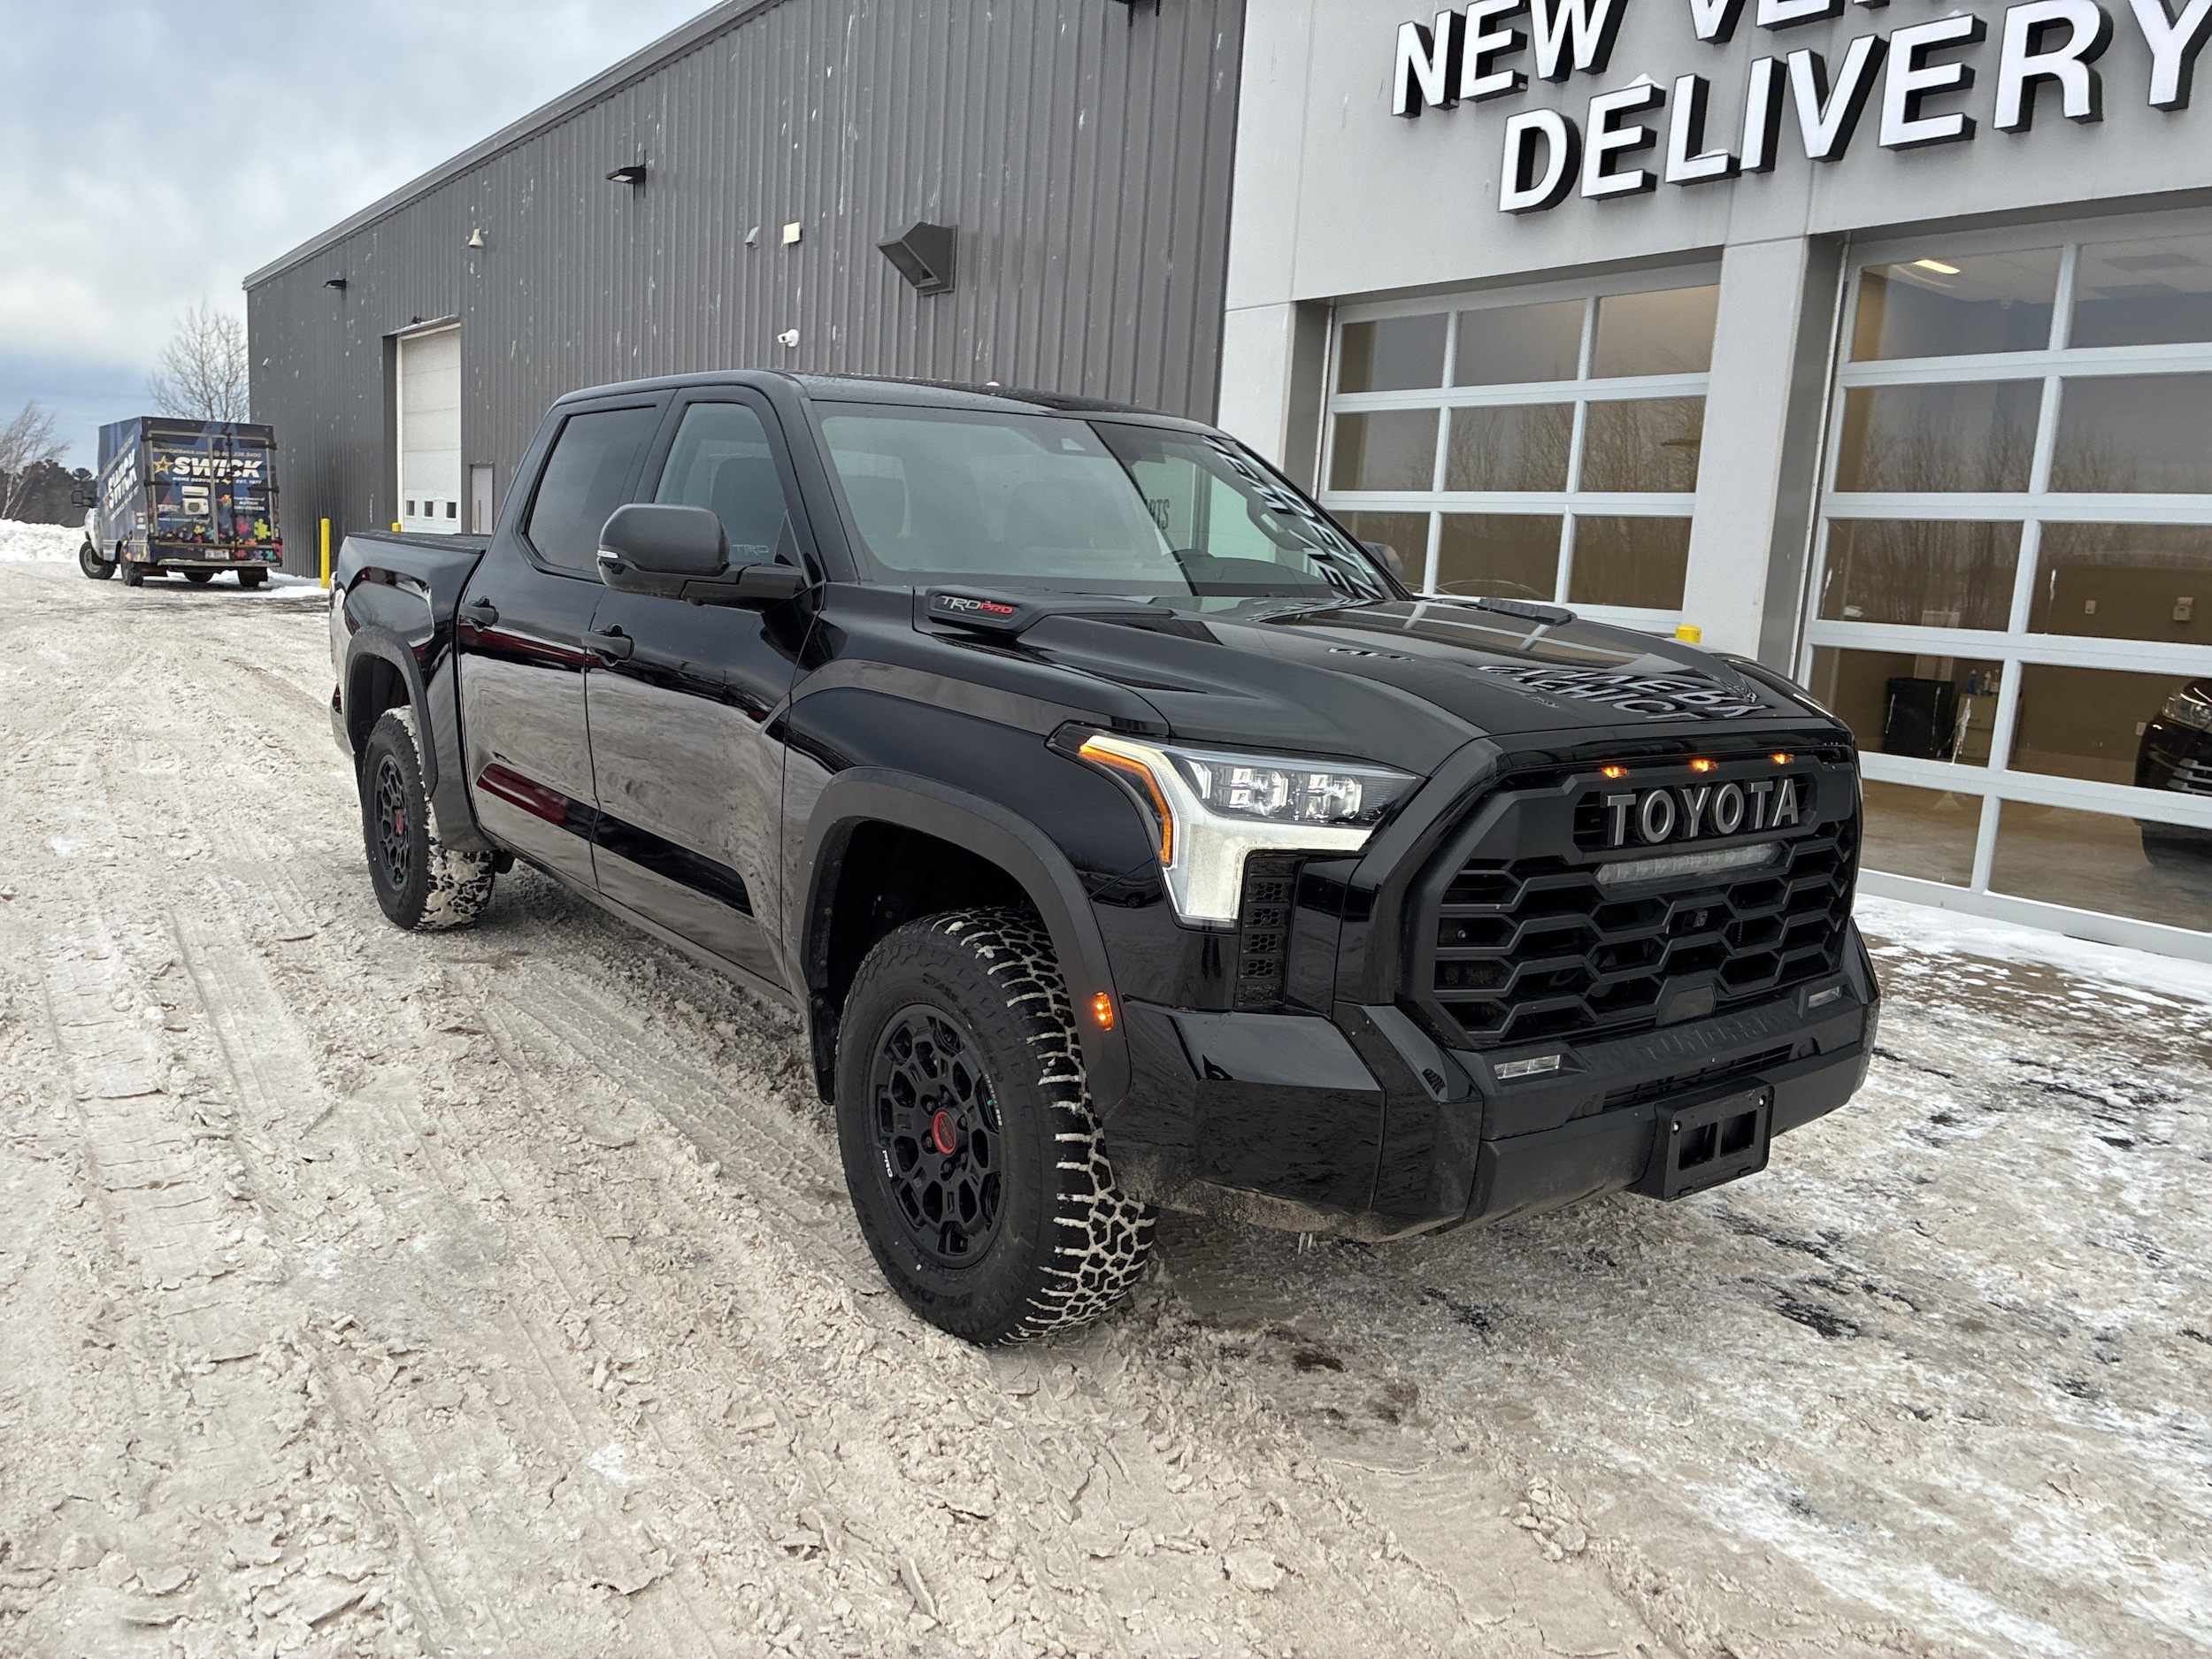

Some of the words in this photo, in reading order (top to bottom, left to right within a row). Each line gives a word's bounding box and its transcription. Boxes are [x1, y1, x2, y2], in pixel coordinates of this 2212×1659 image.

[1392, 0, 1626, 117] NEW
[1497, 0, 2212, 215] DELIVERY
[173, 457, 263, 478] SWICK
[732, 544, 769, 556] TRD
[1606, 777, 1800, 847] TOYOTA
